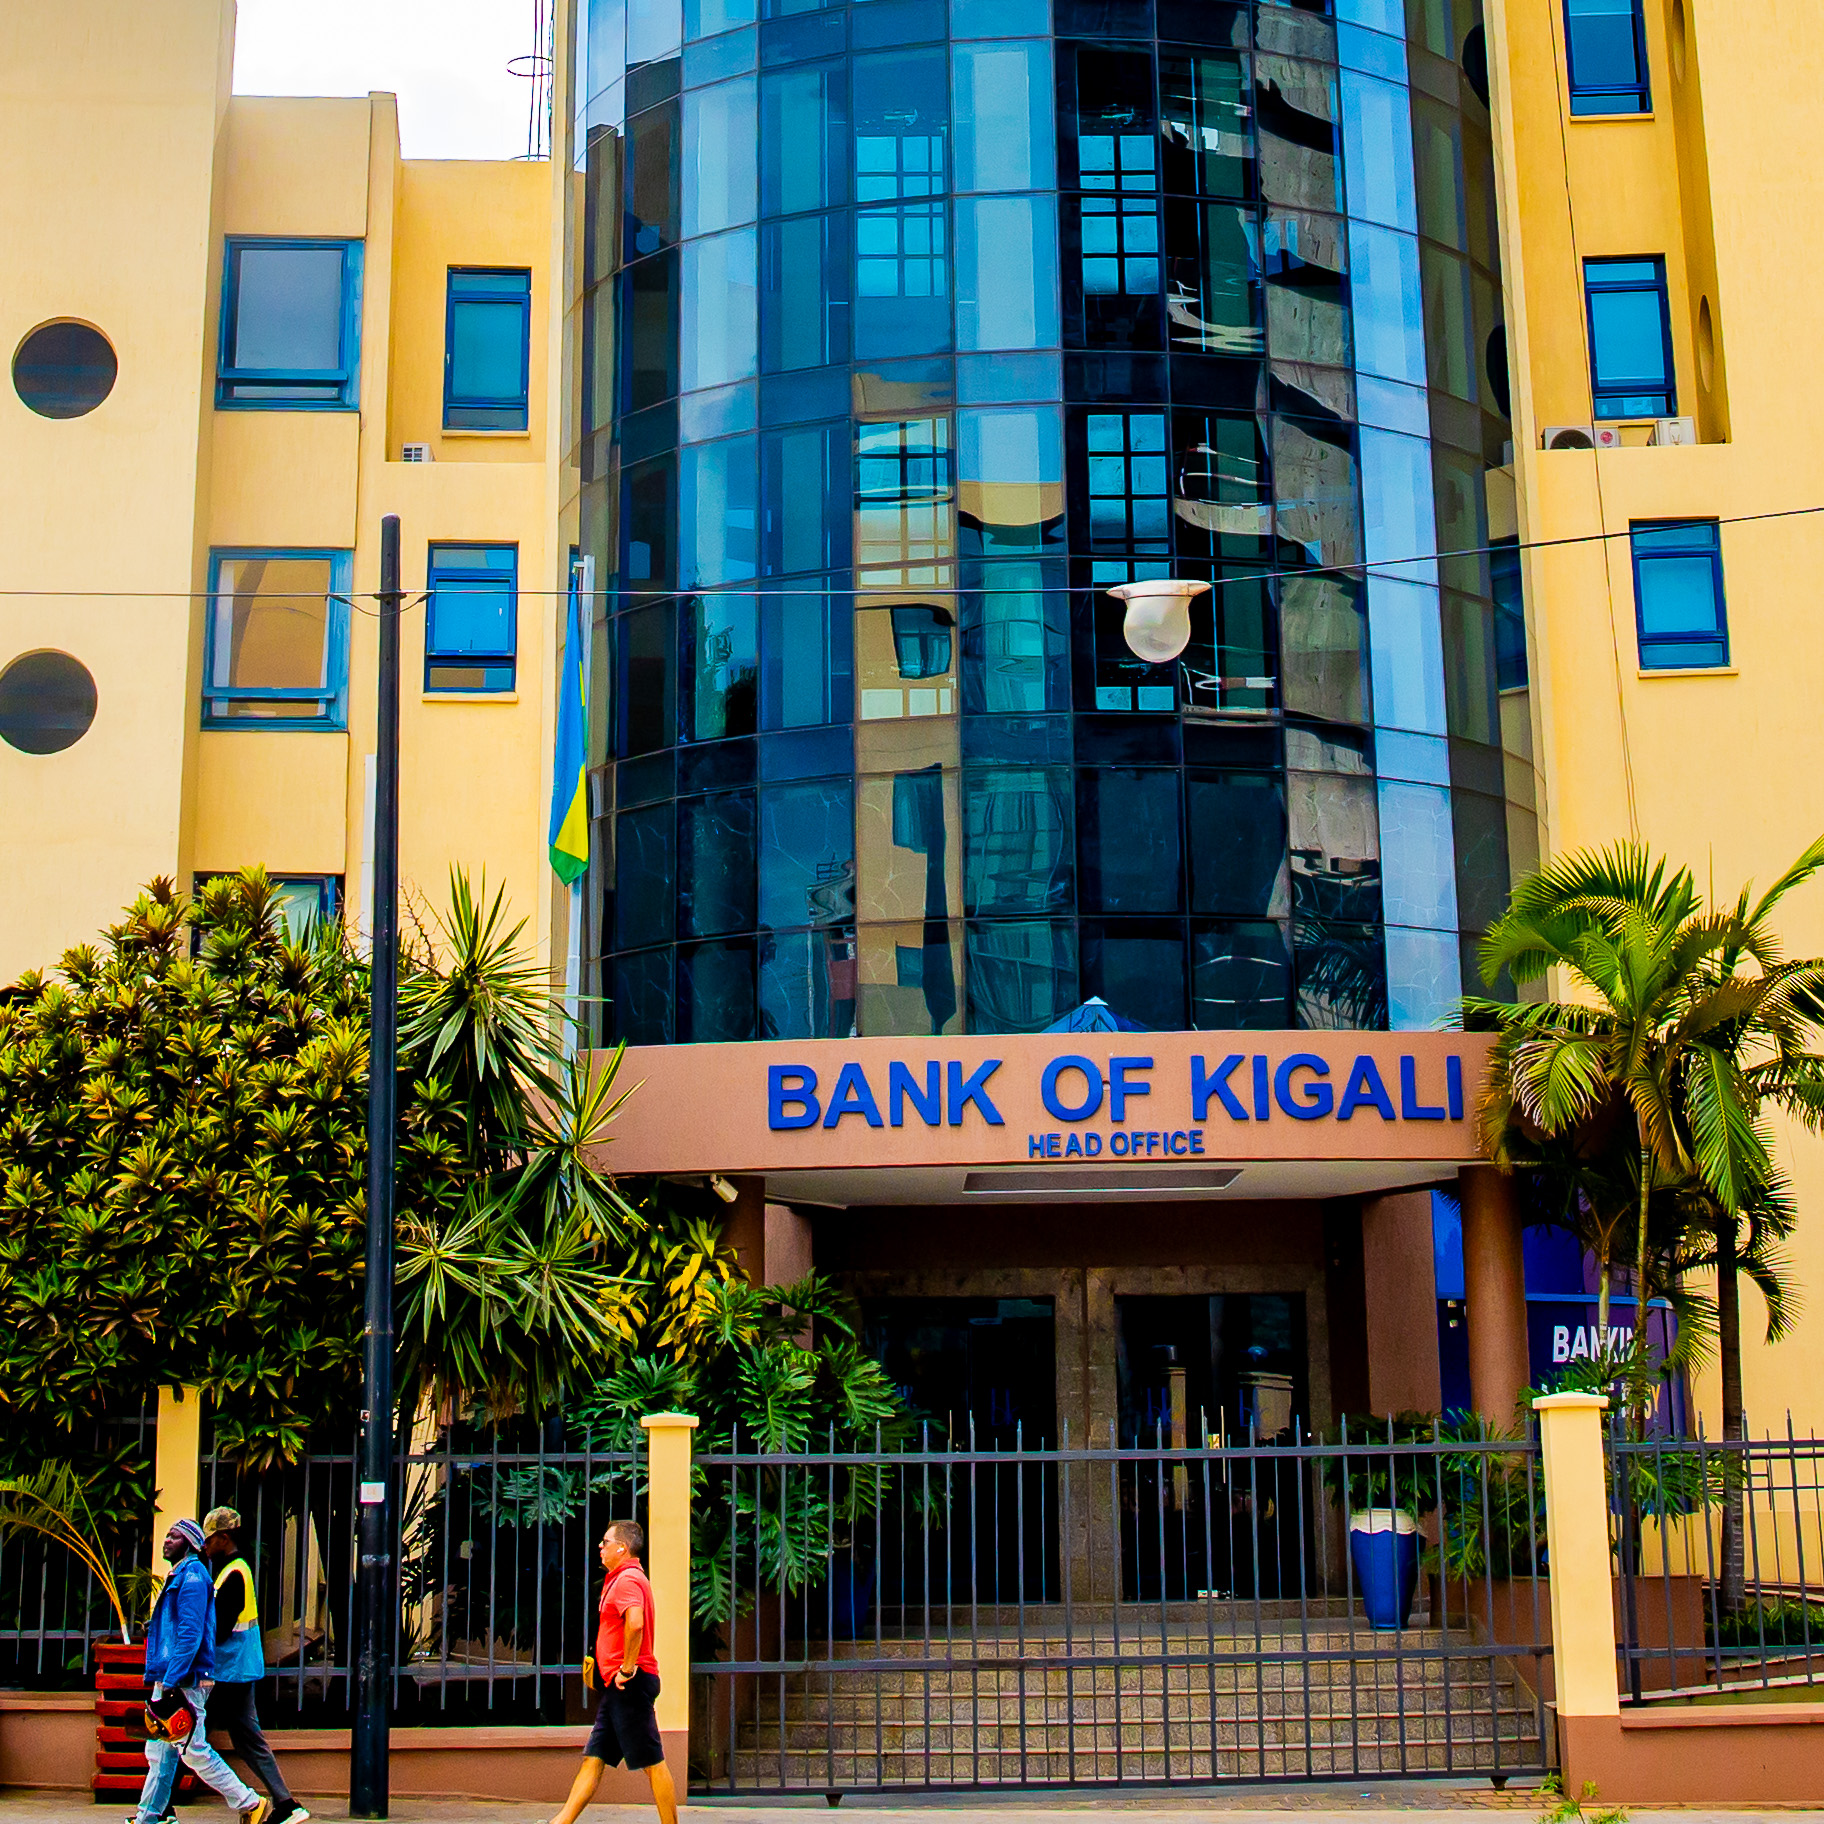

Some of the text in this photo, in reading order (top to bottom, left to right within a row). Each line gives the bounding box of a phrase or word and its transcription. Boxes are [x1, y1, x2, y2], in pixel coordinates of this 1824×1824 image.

[768, 1053, 1463, 1130] BANK OF KIGALI
[1028, 1129, 1205, 1159] HEAD OFFICE
